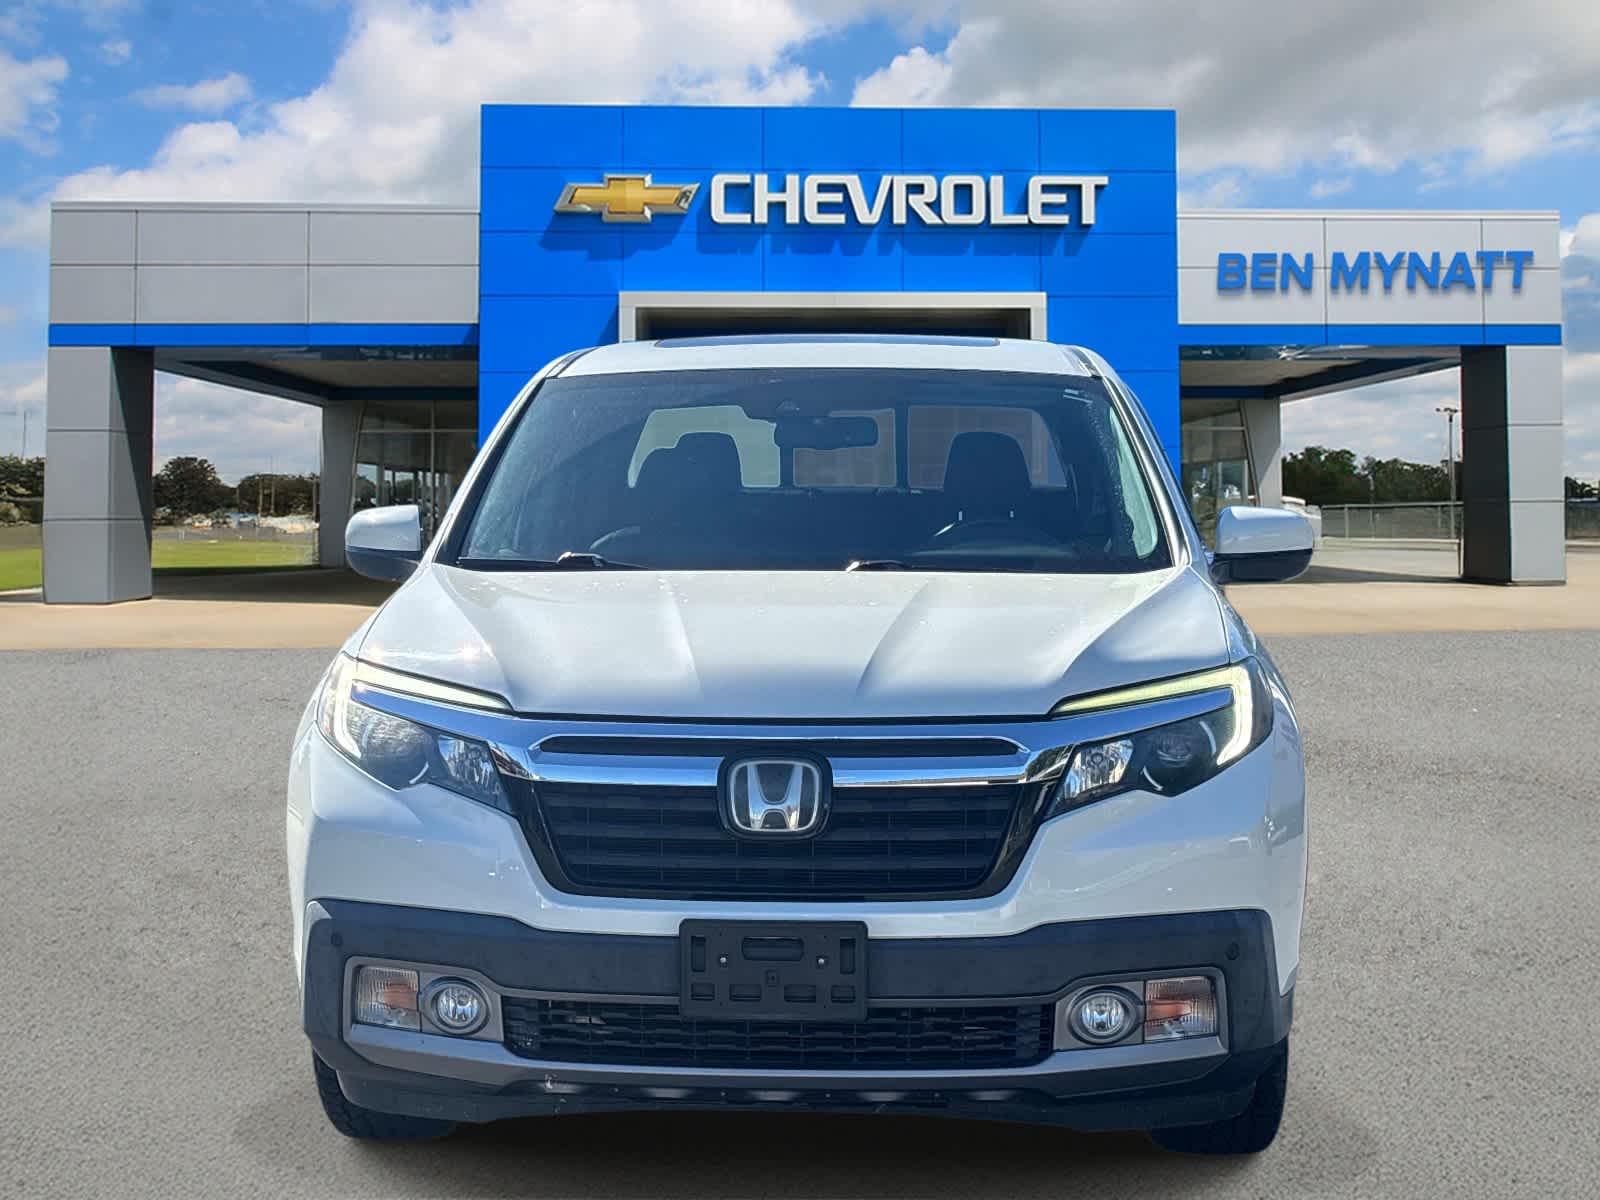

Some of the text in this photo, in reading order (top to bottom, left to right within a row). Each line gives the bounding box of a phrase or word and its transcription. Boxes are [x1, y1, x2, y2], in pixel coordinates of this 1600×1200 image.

[710, 174, 1109, 225] CHEVROLET
[1217, 250, 1534, 290] BEN MYNATT
